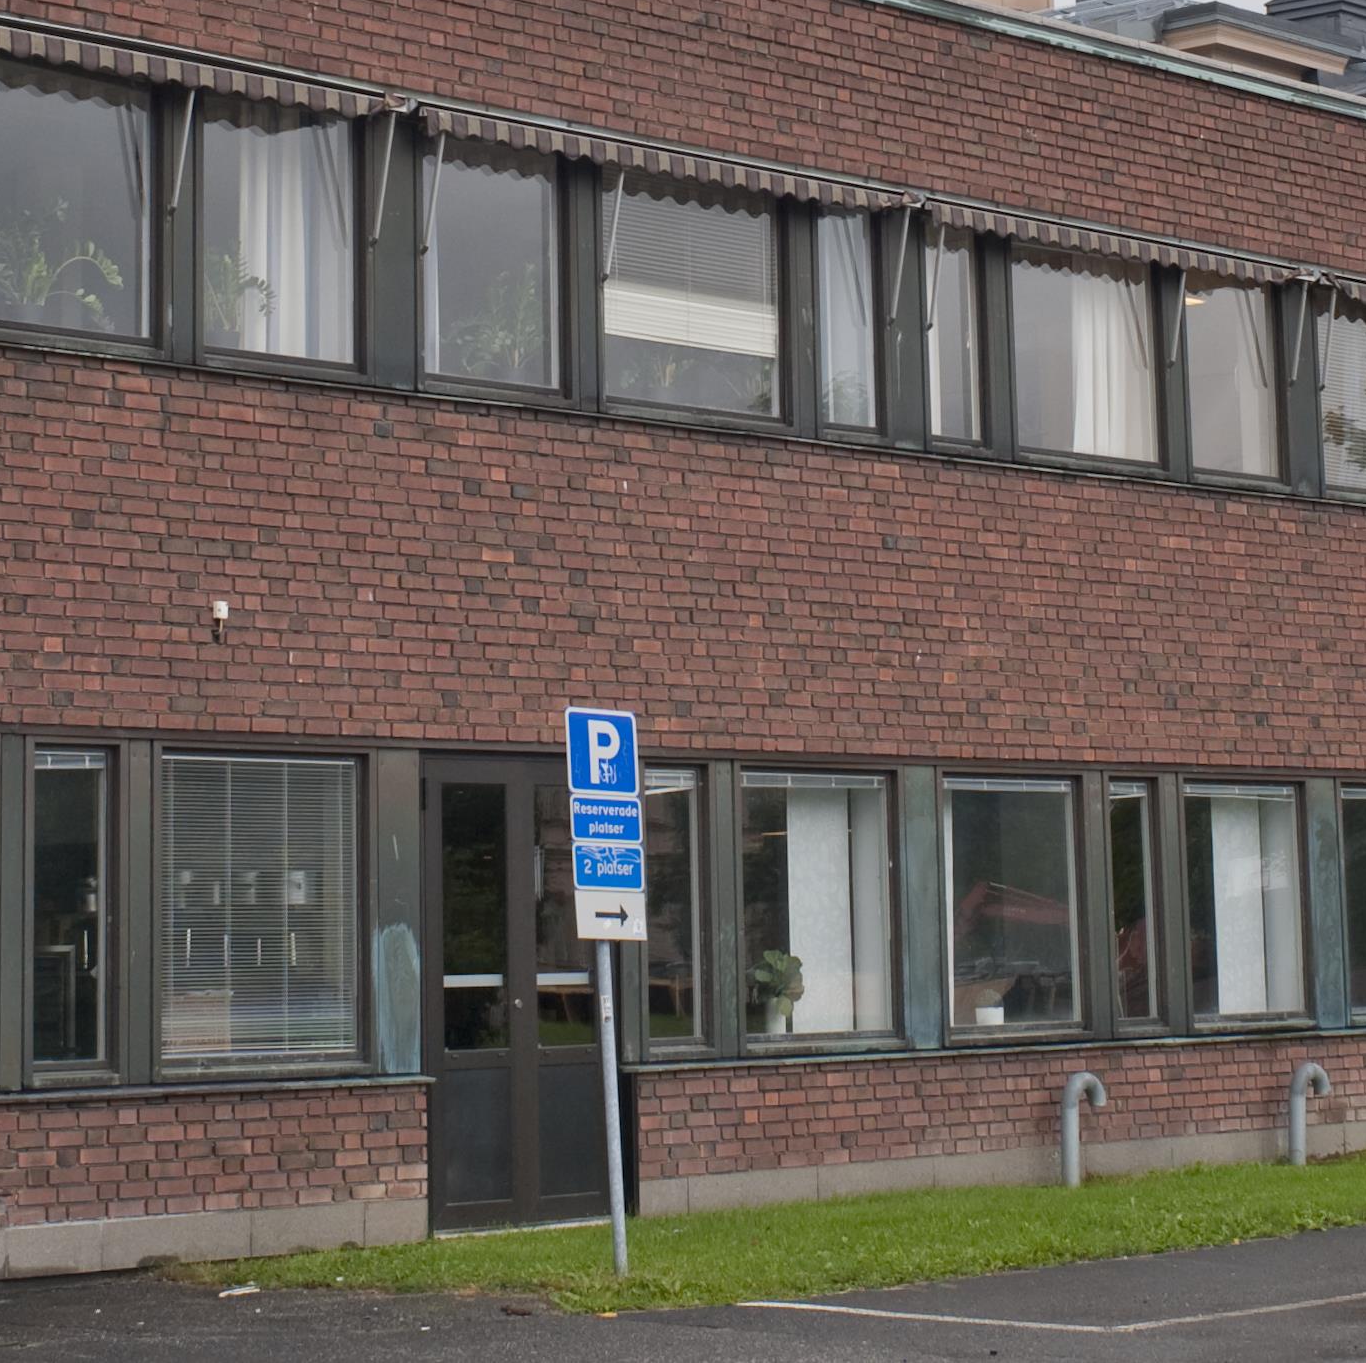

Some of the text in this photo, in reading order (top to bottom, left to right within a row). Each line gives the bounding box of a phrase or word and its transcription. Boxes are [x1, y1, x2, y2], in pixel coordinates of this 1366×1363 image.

[587, 719, 621, 784] P
[573, 801, 638, 817] Reserverade
[588, 821, 625, 836] platser
[583, 858, 635, 877] 2 platser
